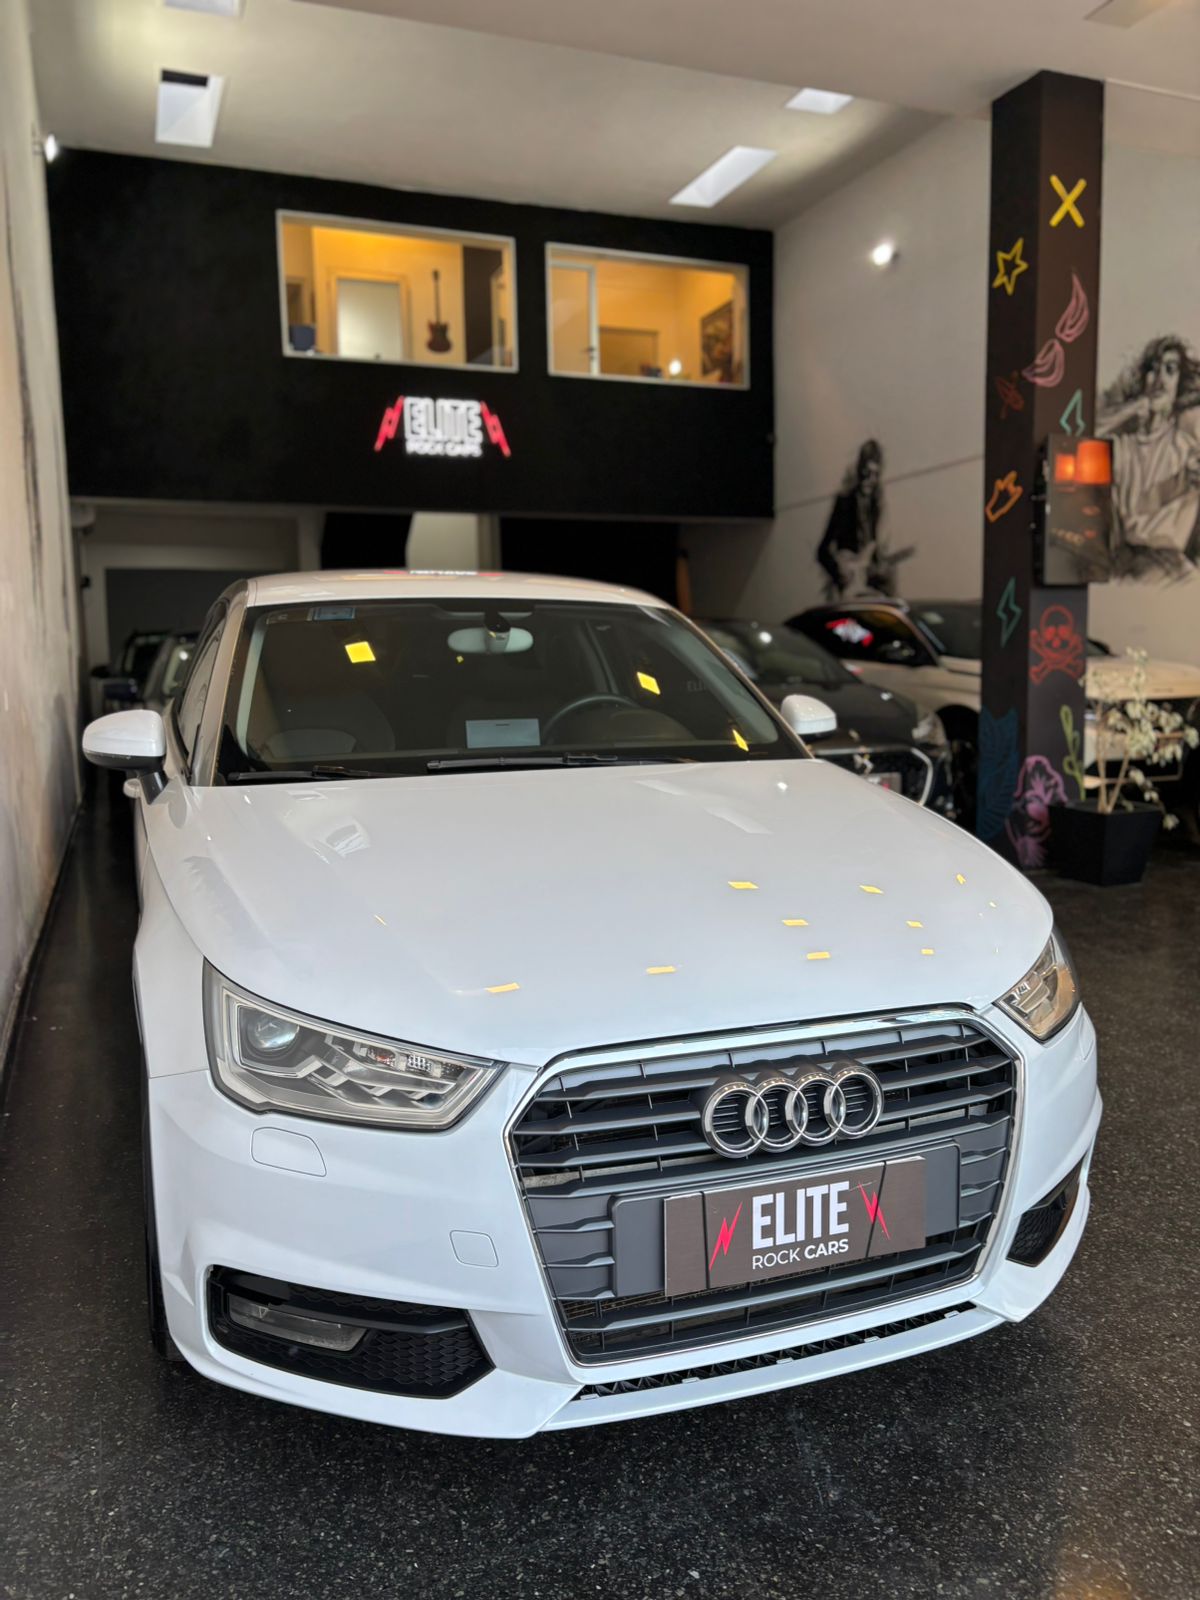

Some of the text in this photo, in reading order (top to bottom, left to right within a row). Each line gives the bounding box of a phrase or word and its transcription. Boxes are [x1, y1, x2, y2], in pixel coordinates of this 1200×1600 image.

[403, 396, 483, 440] ELITE
[752, 1180, 850, 1250] ELITE
[752, 1238, 849, 1270] ROCK CARS
